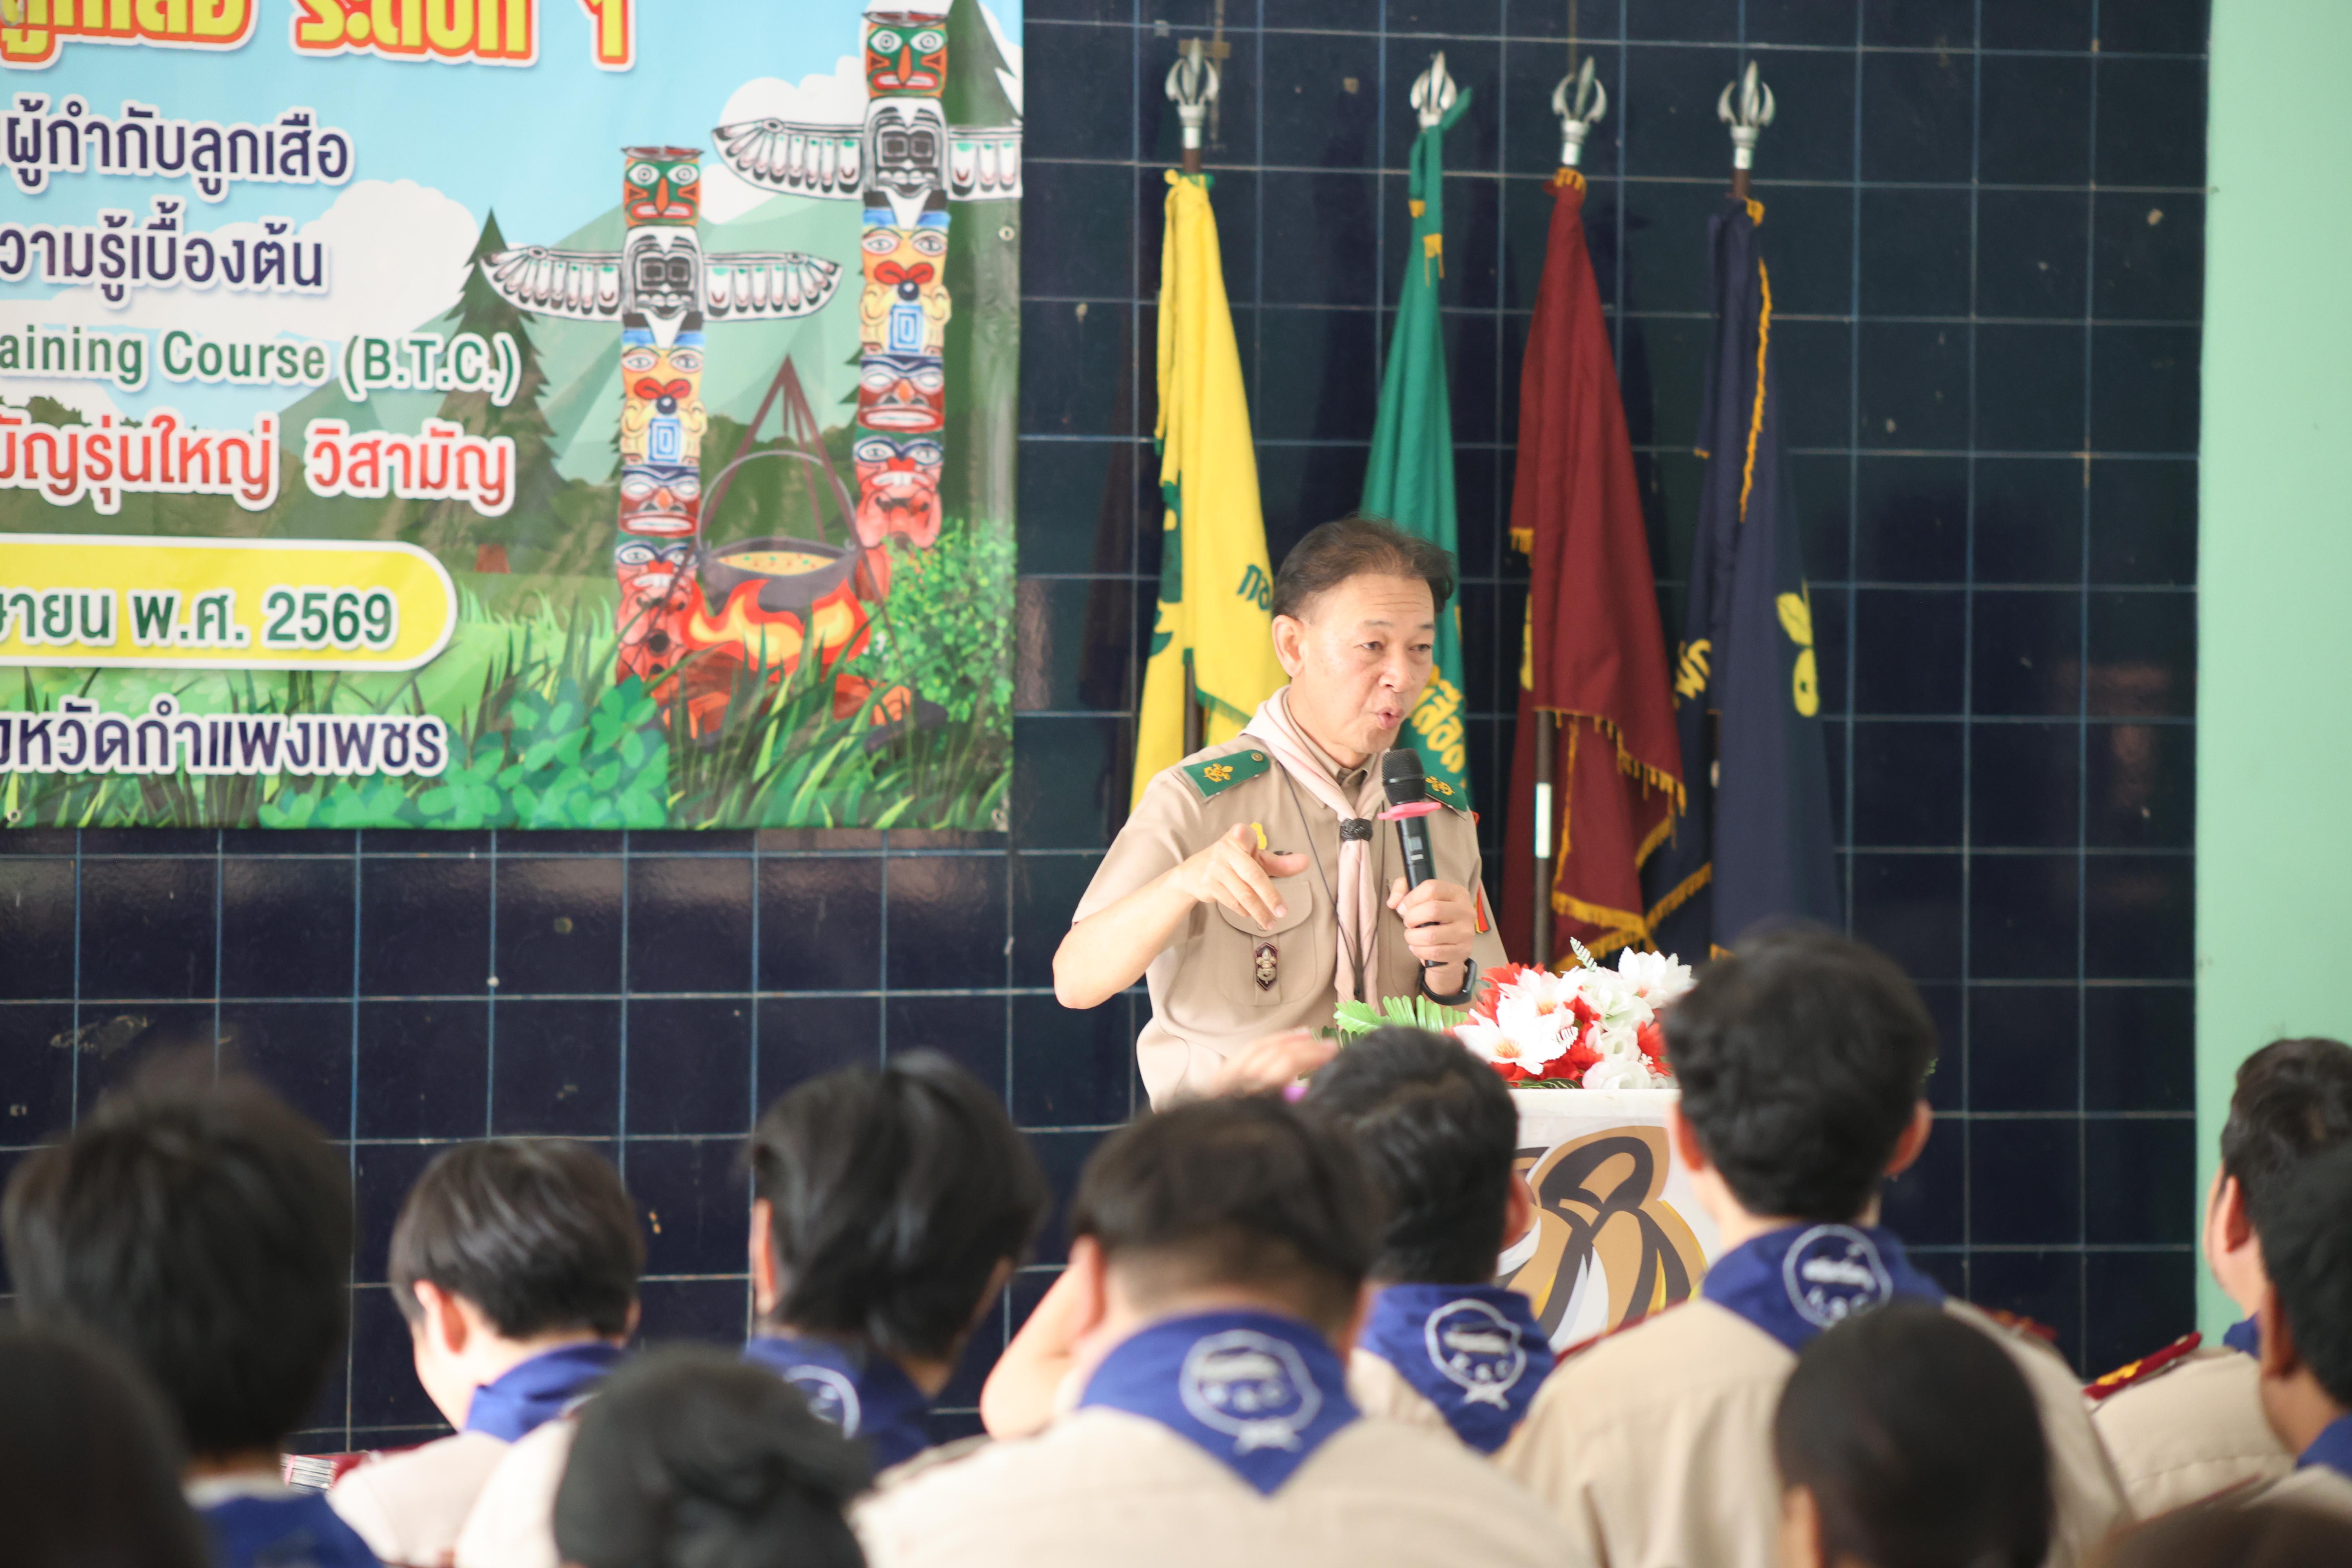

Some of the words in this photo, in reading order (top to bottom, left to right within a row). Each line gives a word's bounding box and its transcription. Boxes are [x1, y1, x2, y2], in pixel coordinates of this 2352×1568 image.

[7, 98, 348, 196] ผู้กำกับลูกเสือ
[0, 325, 142, 385] aining
[164, 330, 324, 379] Course
[345, 335, 514, 398] (B.T.C.)
[313, 426, 506, 506] วิสามัญ
[0, 593, 110, 639] ายน
[133, 595, 243, 640] พ.ศ.
[267, 592, 391, 642] 2569
